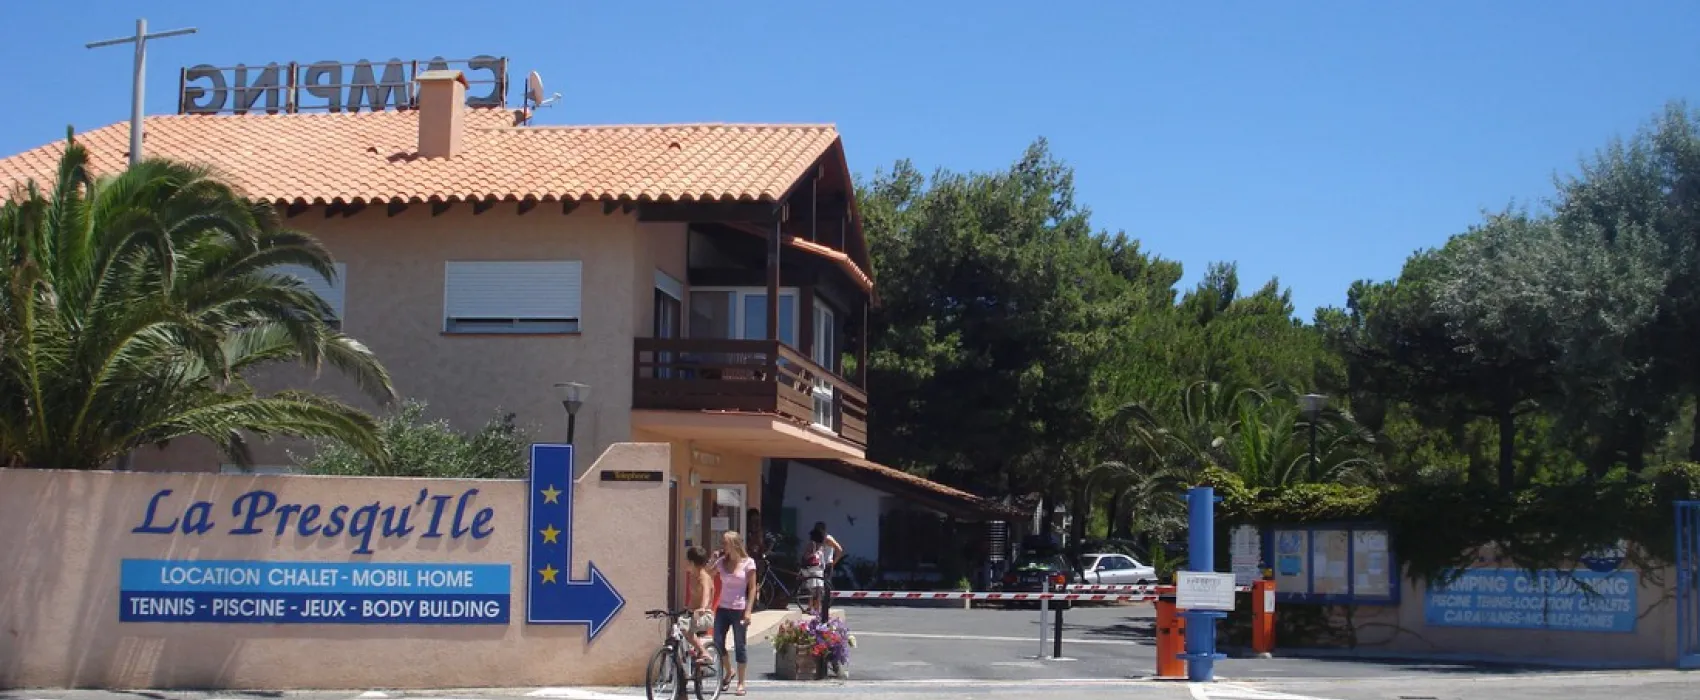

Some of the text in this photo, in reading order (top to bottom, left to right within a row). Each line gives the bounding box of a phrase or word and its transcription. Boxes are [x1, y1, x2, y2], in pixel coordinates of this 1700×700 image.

[131, 487, 495, 555] La Presqu'Ile
[161, 566, 260, 586] LOCATION
[267, 568, 339, 588] CHALET
[352, 569, 412, 588] MOBIL
[416, 570, 474, 588] HOME
[130, 597, 196, 617] TENNIS
[211, 599, 286, 618] PISCINE
[300, 600, 346, 618] JEUX
[362, 600, 414, 618] BODY
[418, 600, 501, 619] BULDING
